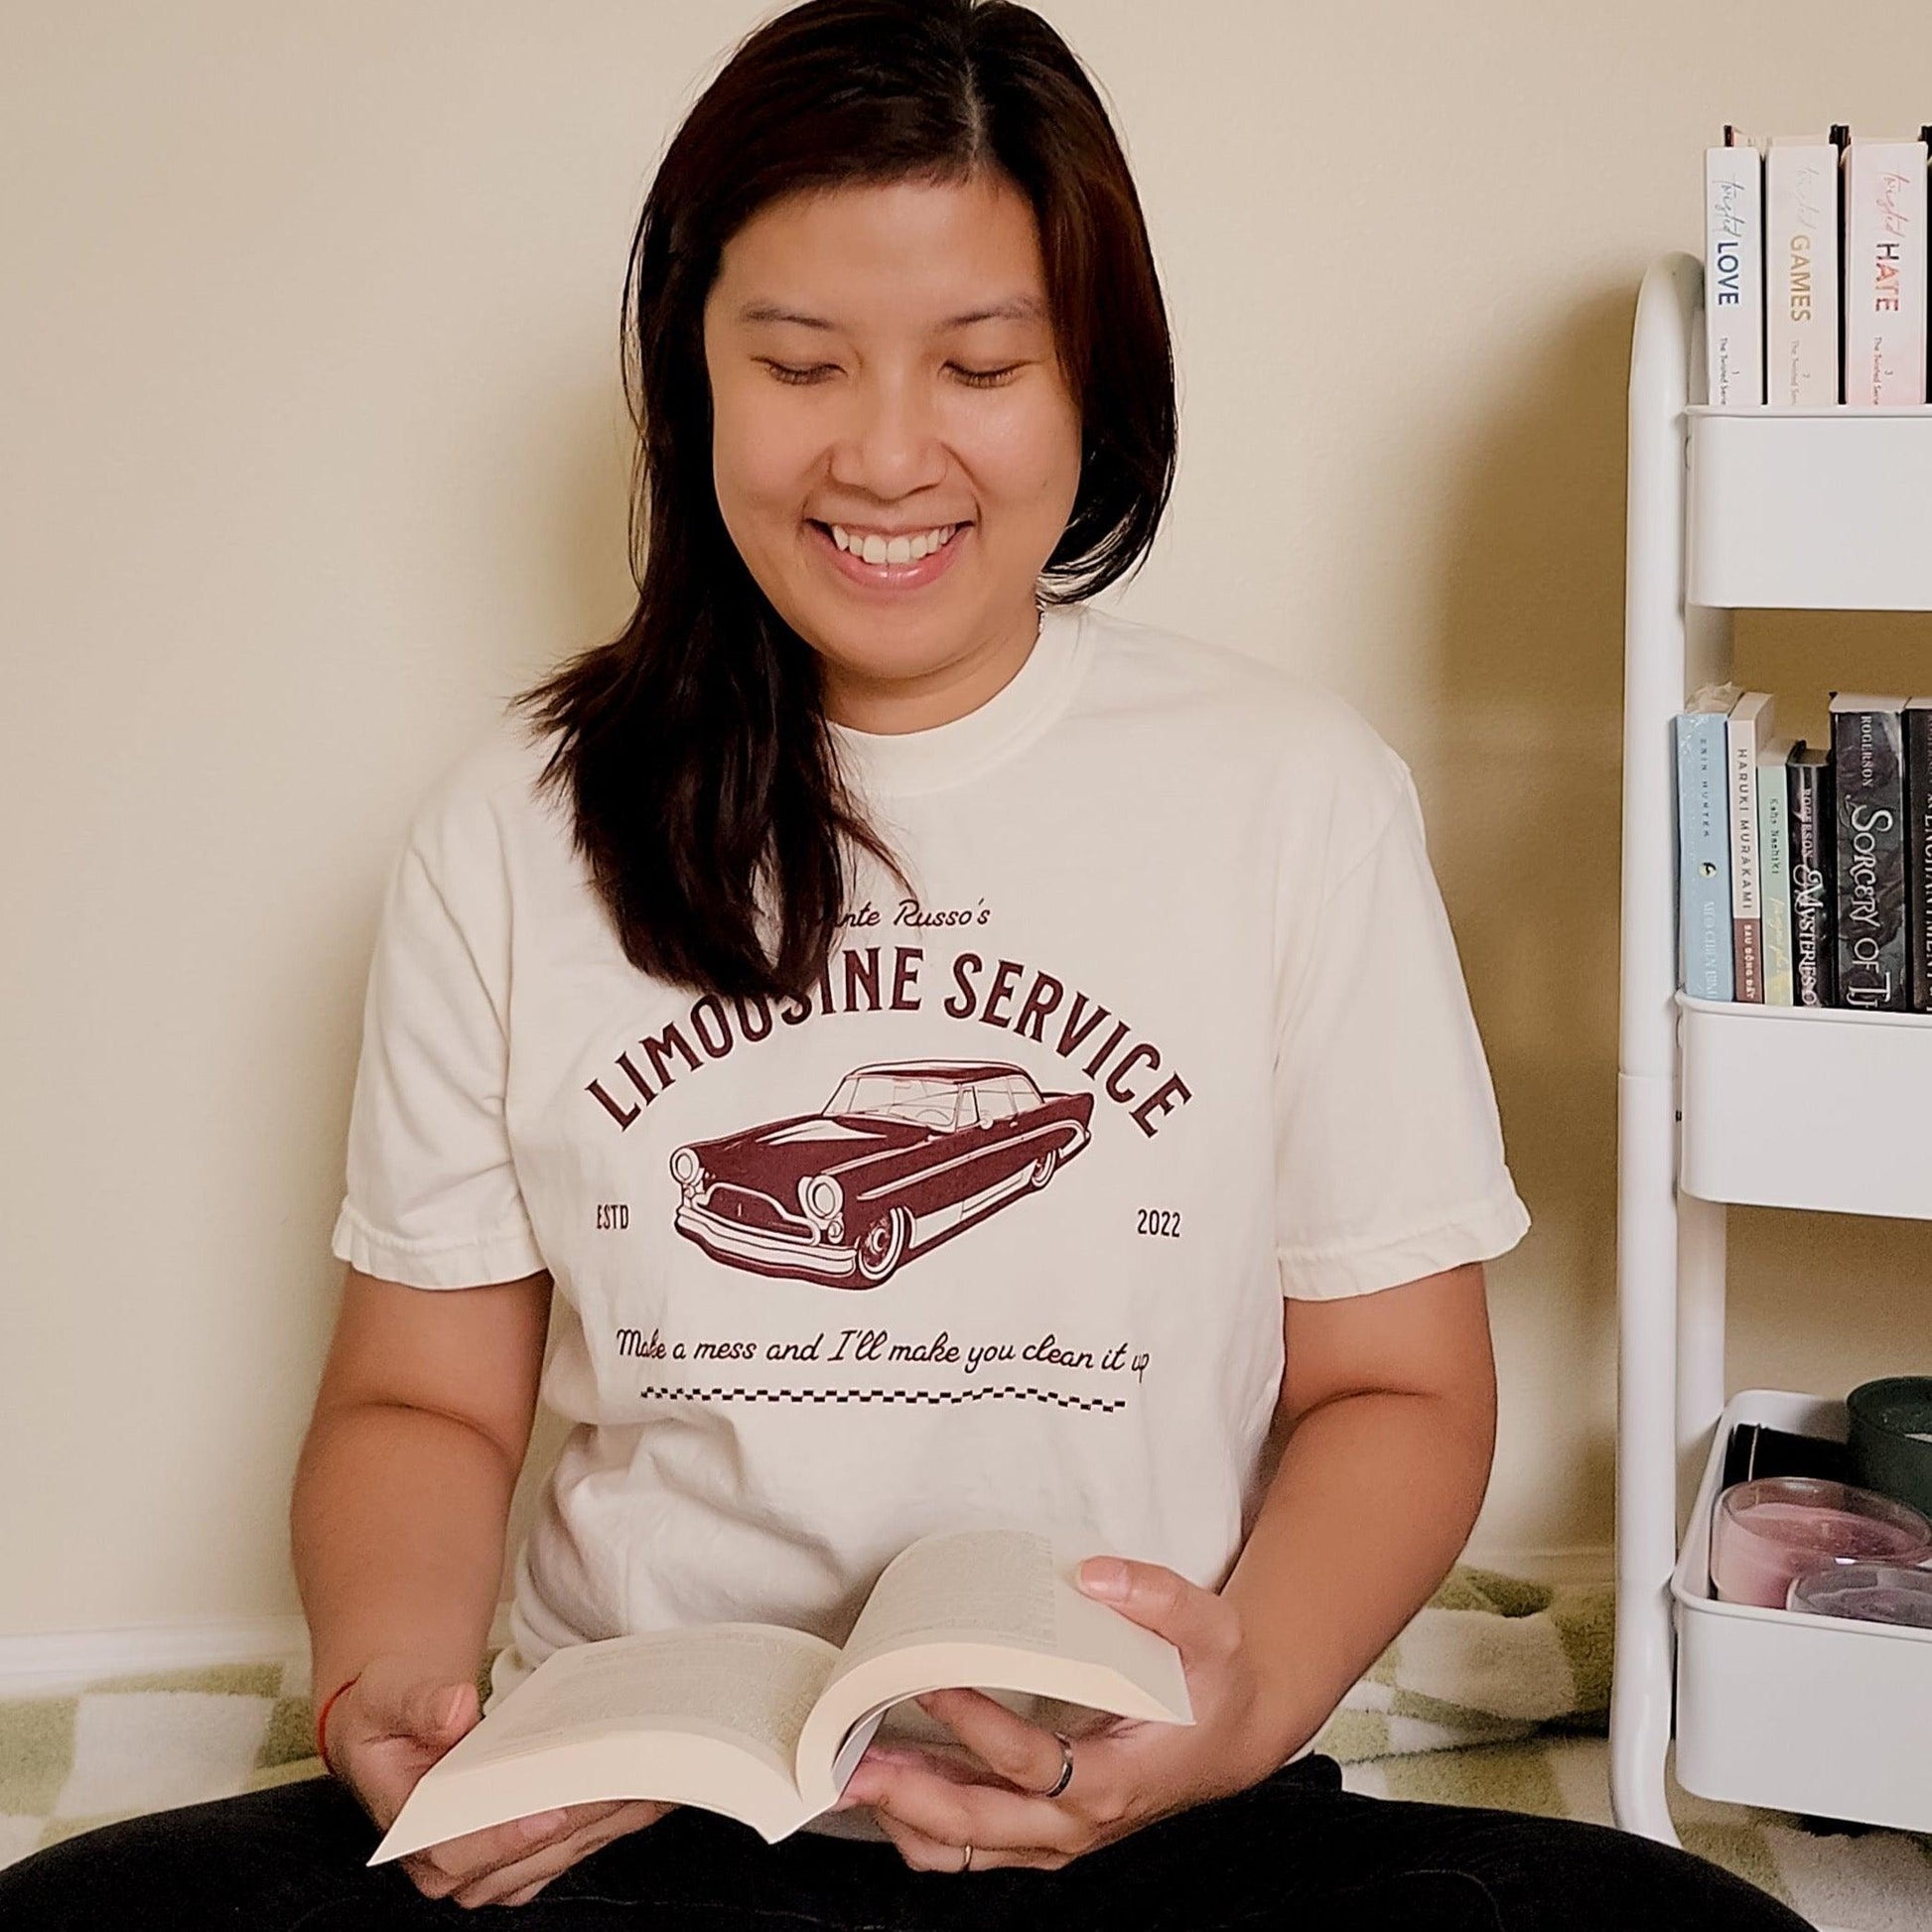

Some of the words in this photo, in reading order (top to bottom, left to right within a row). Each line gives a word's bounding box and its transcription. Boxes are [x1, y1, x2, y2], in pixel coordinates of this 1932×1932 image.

[1717, 241, 1739, 306] LOVE
[1790, 234, 1812, 323] GAMES
[1875, 242, 1900, 313] HATE
[1737, 748, 1750, 812] HARUKI
[1861, 715, 1874, 788] ROGERSON
[1739, 819, 1753, 909] MURAKAMI
[1849, 804, 1894, 928] SORCERY
[893, 897, 991, 927] Russo's
[1743, 924, 1753, 944] SAU
[1852, 937, 1880, 974] OF
[1802, 990, 1818, 1005] O
[943, 952, 1193, 1139] SERVICE
[596, 1203, 629, 1230] ESTD
[1137, 1208, 1181, 1239] 2022
[616, 1327, 667, 1360] Make
[672, 1341, 687, 1360] a
[693, 1341, 758, 1360] mess
[765, 1331, 824, 1361] and
[827, 1328, 888, 1362] I'll
[888, 1330, 961, 1363] make
[964, 1343, 1016, 1374] you
[1022, 1333, 1095, 1369] clean
[1100, 1342, 1129, 1371] it
